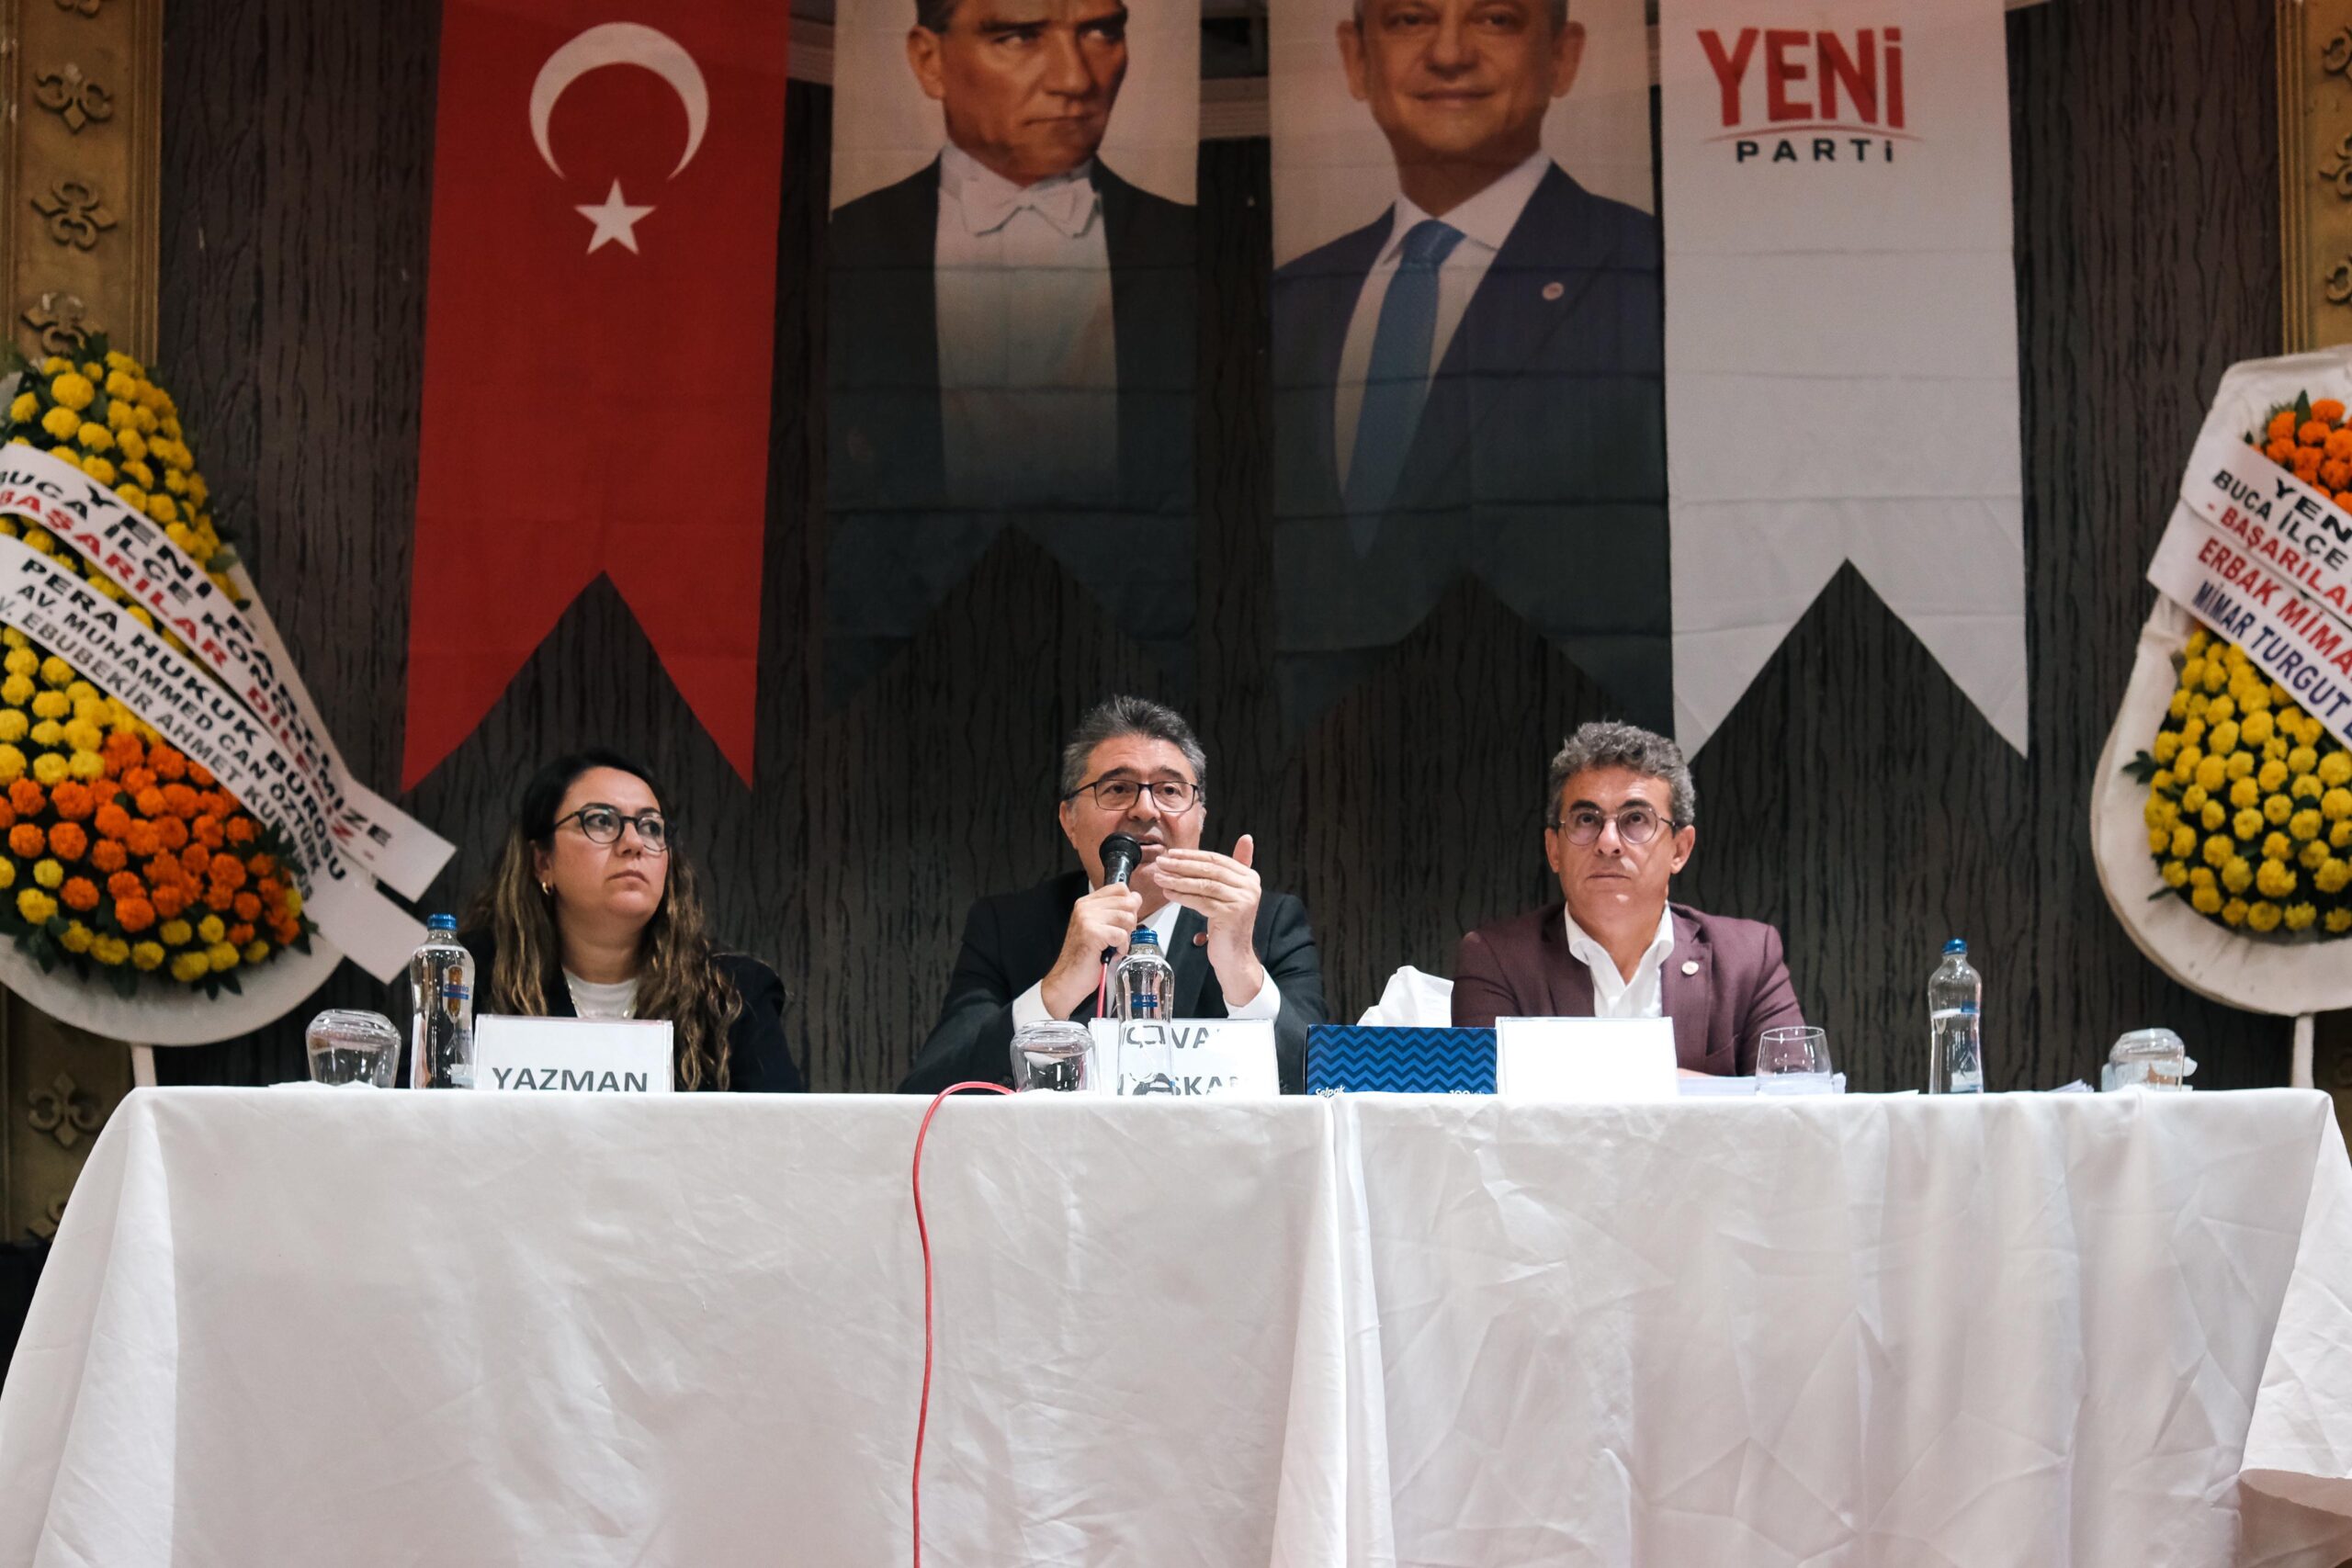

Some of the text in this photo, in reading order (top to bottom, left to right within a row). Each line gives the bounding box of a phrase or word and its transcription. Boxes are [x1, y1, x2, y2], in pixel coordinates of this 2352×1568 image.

[1696, 28, 1905, 130] YENİ
[1736, 139, 1894, 163] PARTİ
[2212, 469, 2349, 571] BUCA İLÇE
[2220, 508, 2352, 615] BAŞARILA
[21, 558, 118, 632] PERA
[131, 634, 259, 746] HUKUK
[2198, 537, 2352, 676] ERBAK MİMA
[17, 585, 57, 615] AV.
[63, 613, 213, 731] MUHAMMED
[219, 734, 266, 779] CAN
[2251, 626, 2351, 717] TURGUT
[156, 714, 243, 783] AHMET
[492, 1067, 648, 1092] YAZMAN
